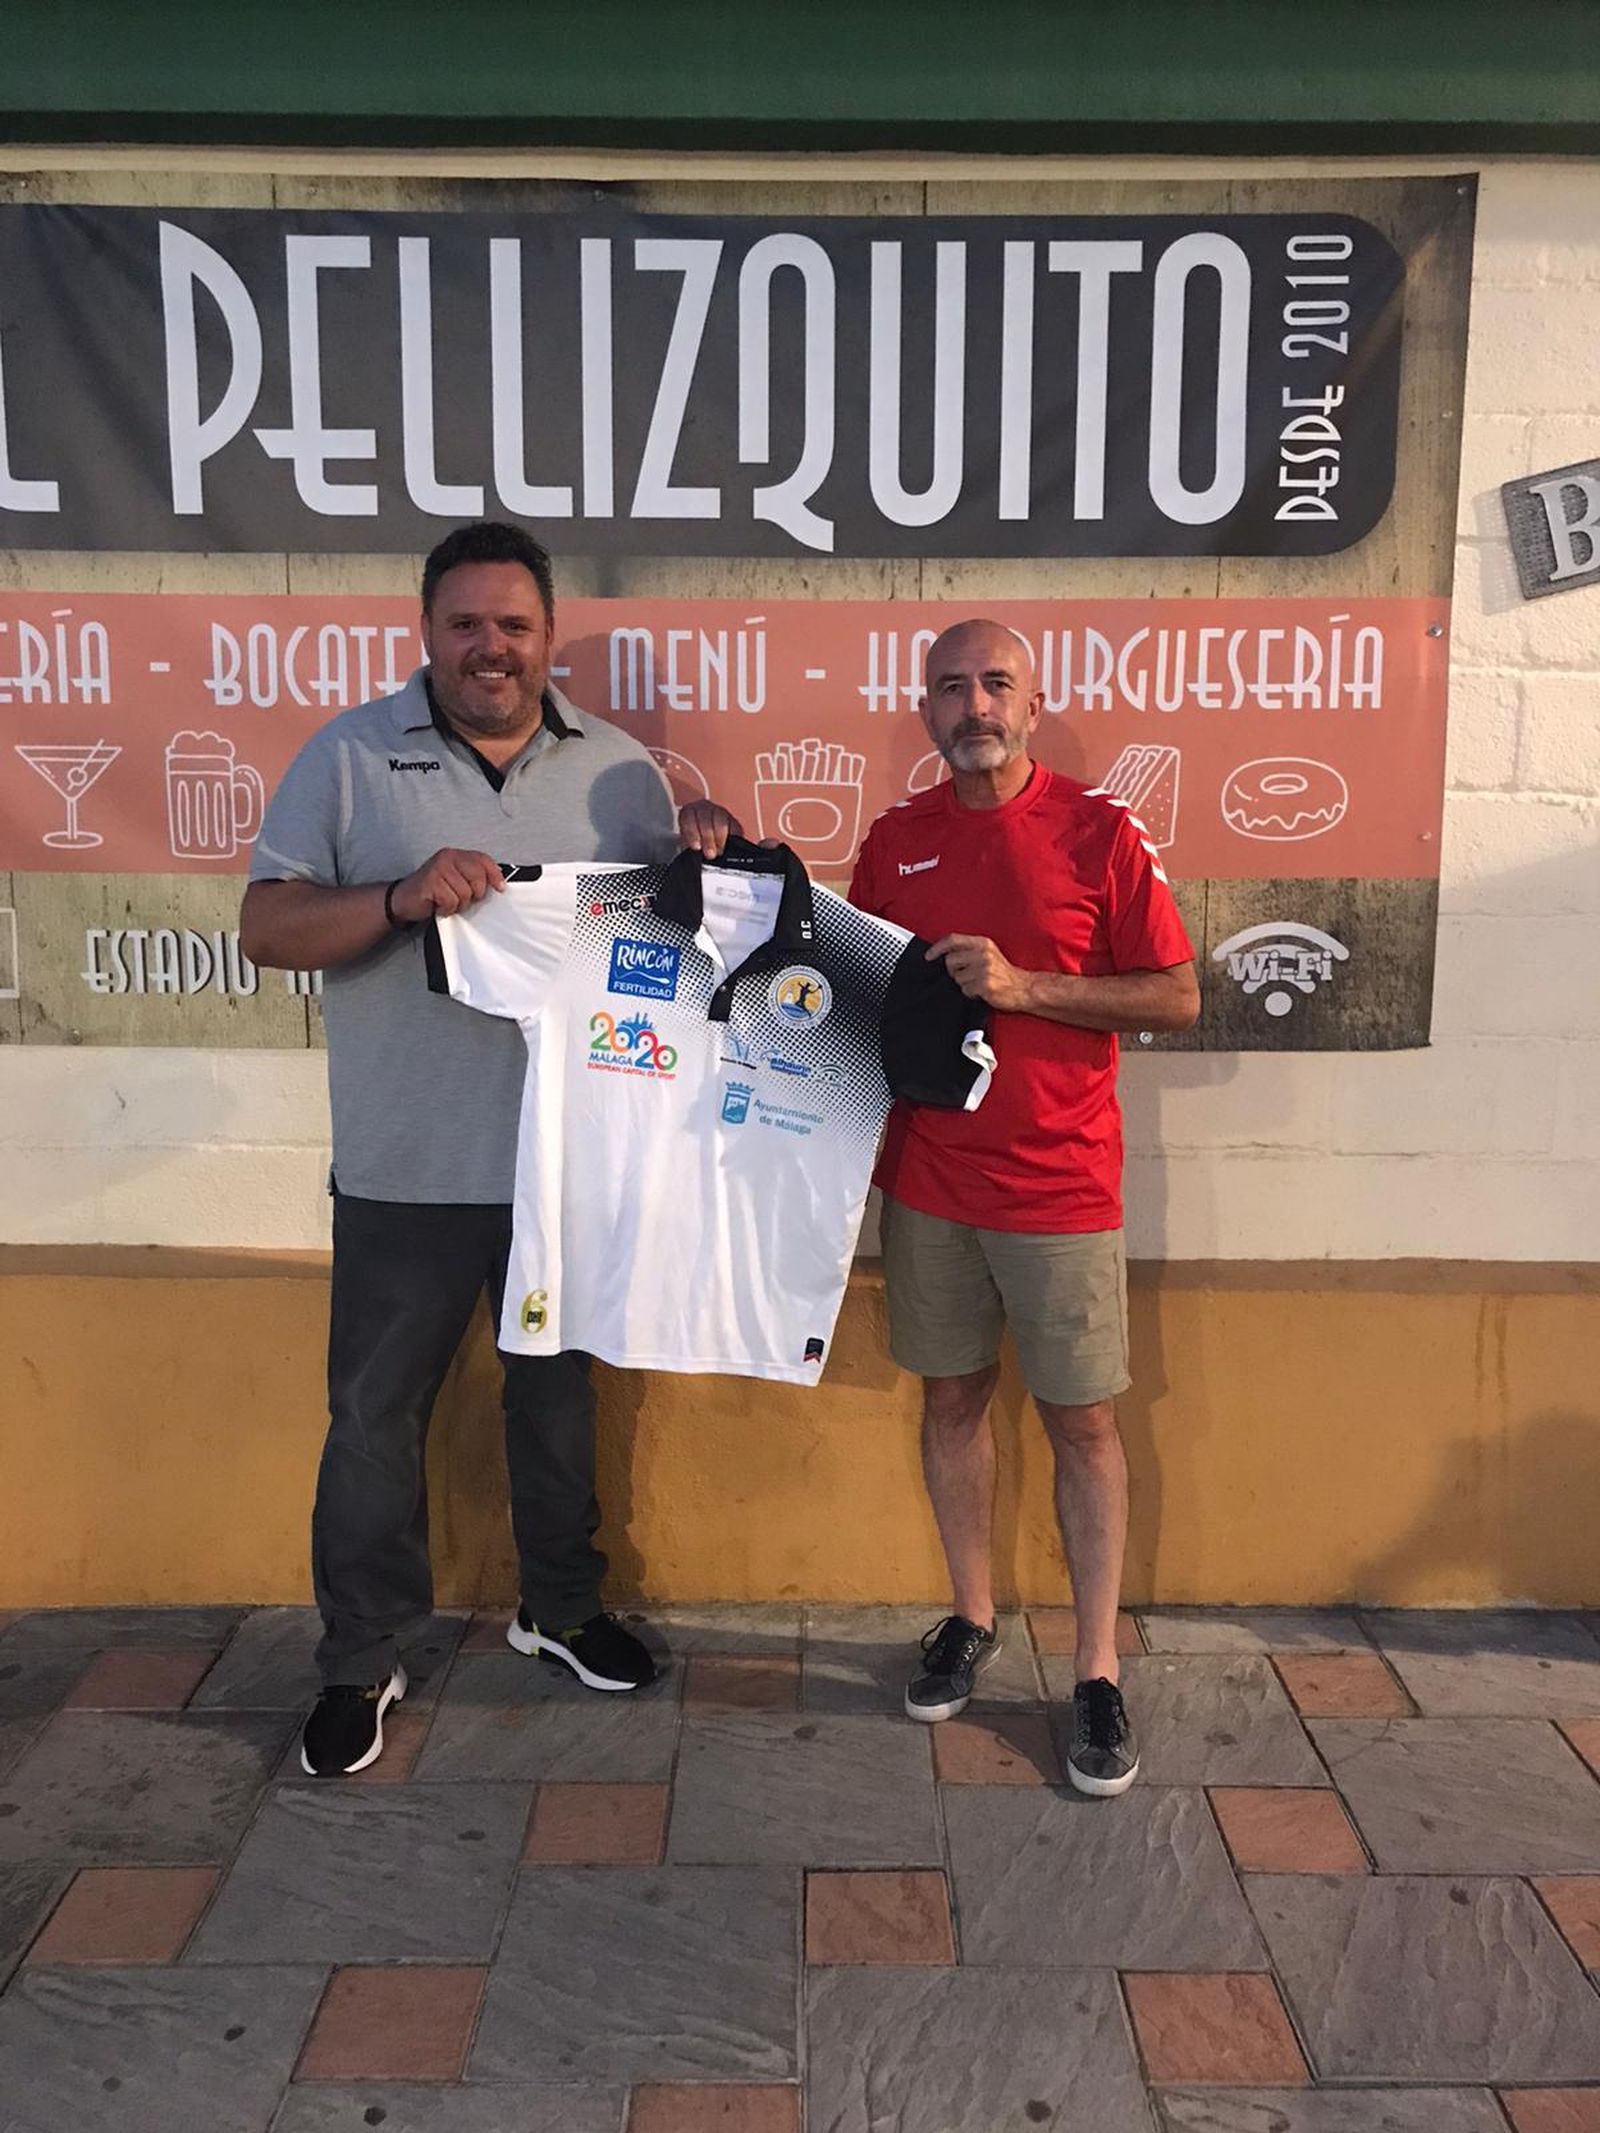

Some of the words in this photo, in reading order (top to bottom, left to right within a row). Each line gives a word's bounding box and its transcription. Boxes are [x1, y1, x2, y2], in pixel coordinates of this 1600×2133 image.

[1281, 234, 1353, 358] 2010
[159, 221, 1252, 552] PELLIZQUITO
[1274, 385, 1345, 521] DESDE
[204, 622, 432, 708] BOCATE
[609, 616, 767, 714] MENÚ
[857, 614, 1384, 713] HAURGUESERÍA
[389, 759, 440, 773] Kempa
[1226, 949, 1334, 981] Wi-Fi
[613, 981, 673, 999] FERTILIDAD
[589, 1011, 678, 1071] 2020
[753, 1098, 825, 1125] Ayuntamiento
[759, 1113, 773, 1126] de
